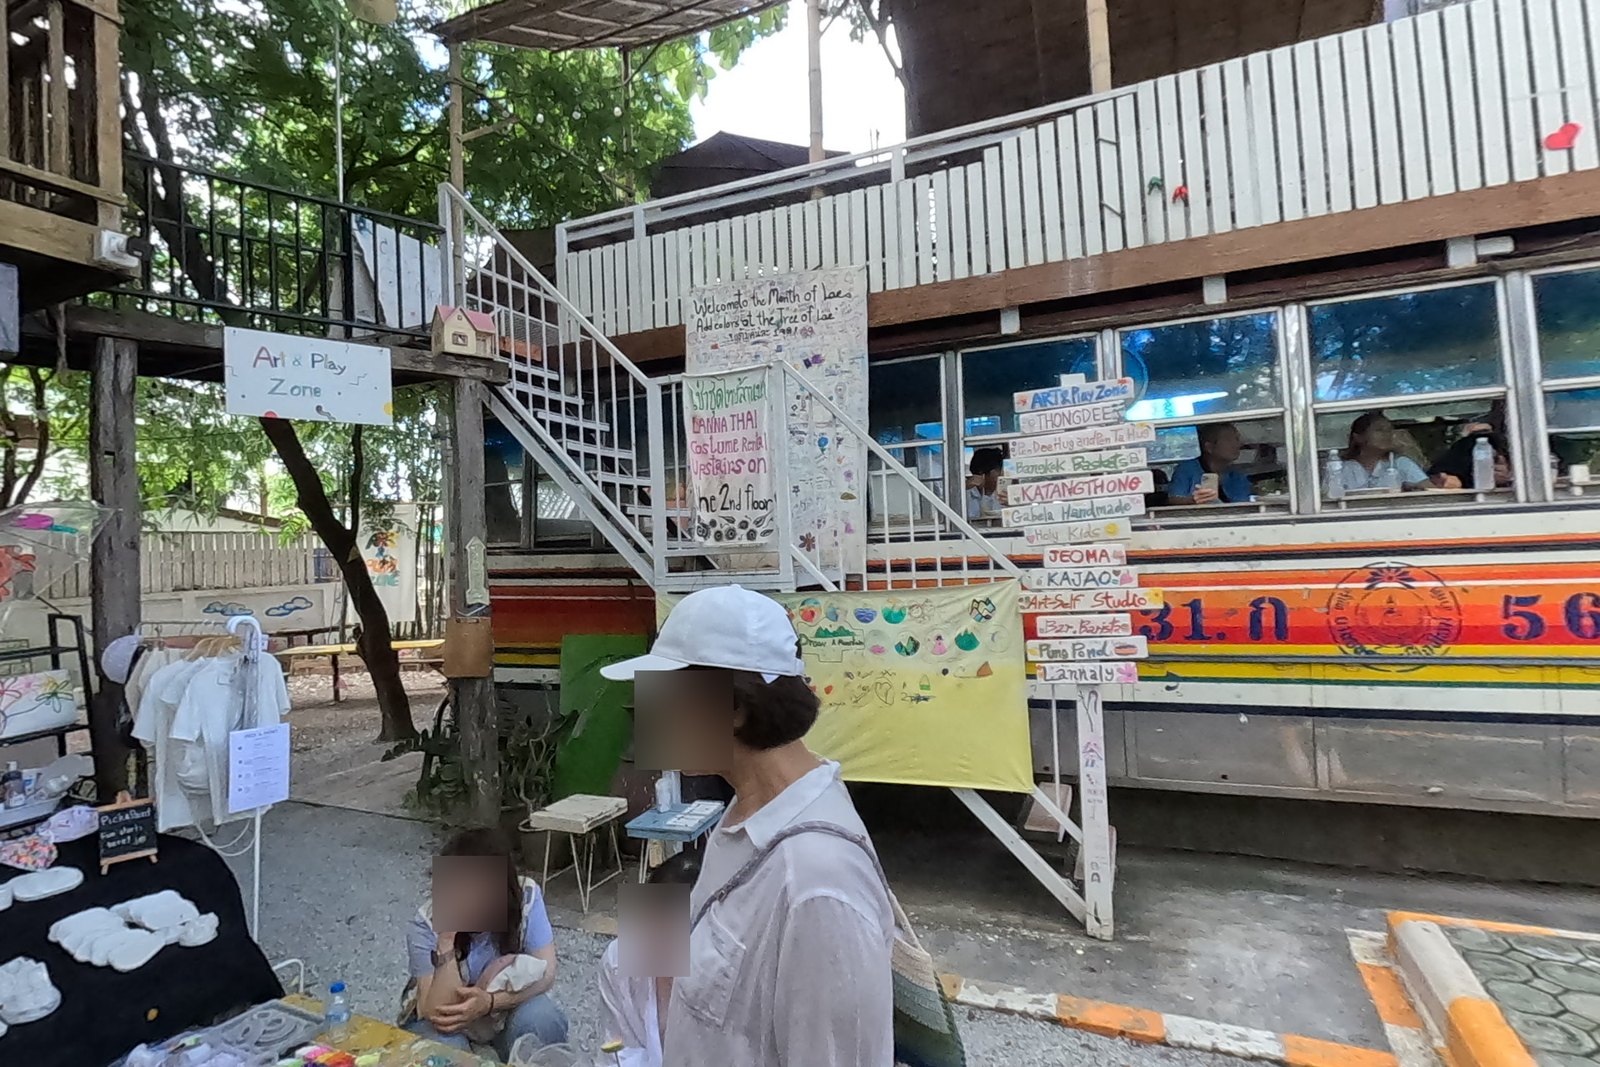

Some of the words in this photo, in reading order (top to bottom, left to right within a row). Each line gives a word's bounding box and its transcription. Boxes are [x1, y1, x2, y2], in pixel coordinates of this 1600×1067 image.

[751, 291, 767, 308] the
[768, 287, 800, 306] Month
[804, 284, 818, 302] of
[696, 318, 713, 333] Add
[757, 309, 775, 327] the
[801, 305, 815, 323] of
[253, 346, 286, 368] Art
[292, 357, 303, 367] &
[311, 352, 347, 376] Play
[267, 377, 322, 398] Zone
[692, 416, 728, 434] LANNA
[730, 409, 758, 431] THAI
[1037, 406, 1111, 430] THONGDEE
[748, 457, 767, 474] on
[719, 483, 742, 511] 2nd
[745, 483, 774, 511] floor
[1011, 509, 1055, 524] Gabela
[1062, 500, 1132, 520] Handmade
[1049, 549, 1111, 564] JEOMA
[1047, 570, 1112, 587] KAJAO
[1091, 590, 1148, 609] Studio
